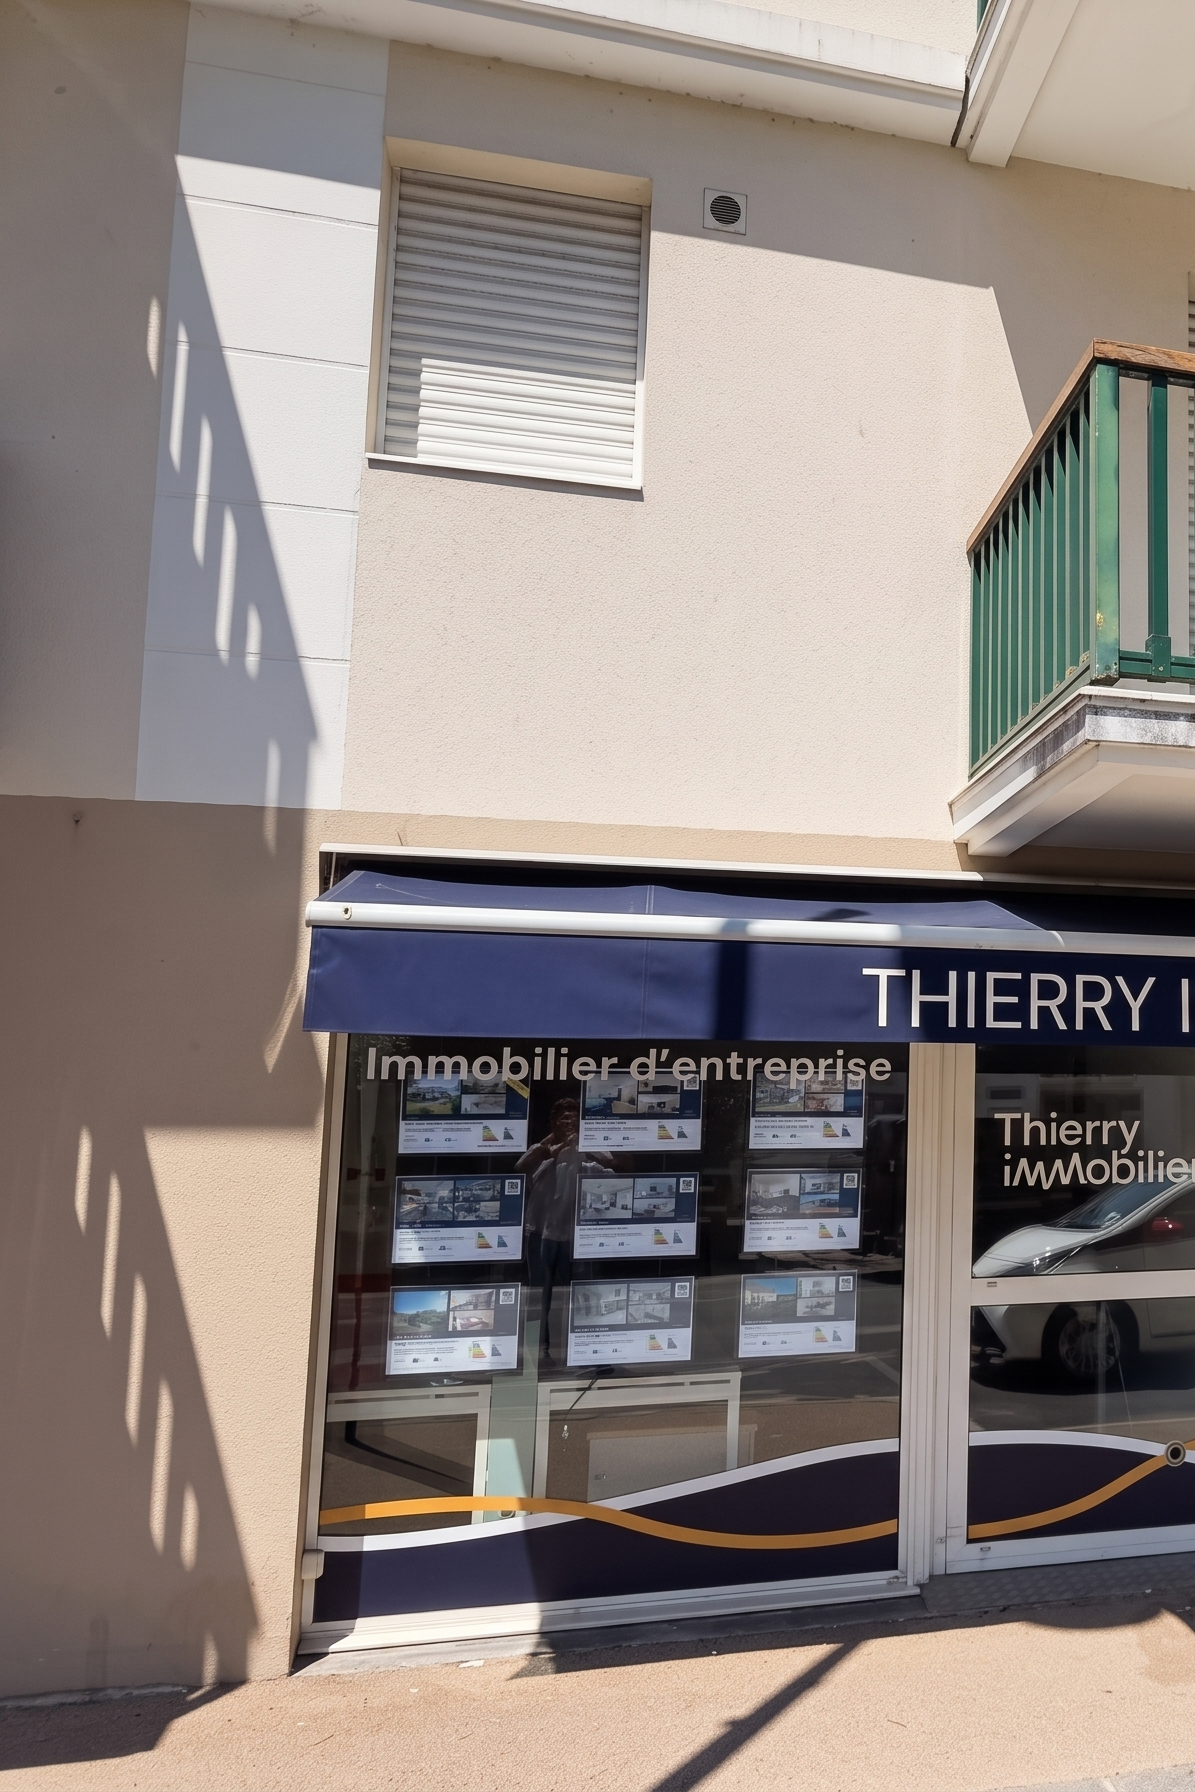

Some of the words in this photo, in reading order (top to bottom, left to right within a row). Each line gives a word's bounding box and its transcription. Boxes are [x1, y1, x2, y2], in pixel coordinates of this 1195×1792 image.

[861, 967, 1156, 1032] THIERRY
[366, 1046, 618, 1082] Immobilier
[994, 1111, 1140, 1154] Thierry
